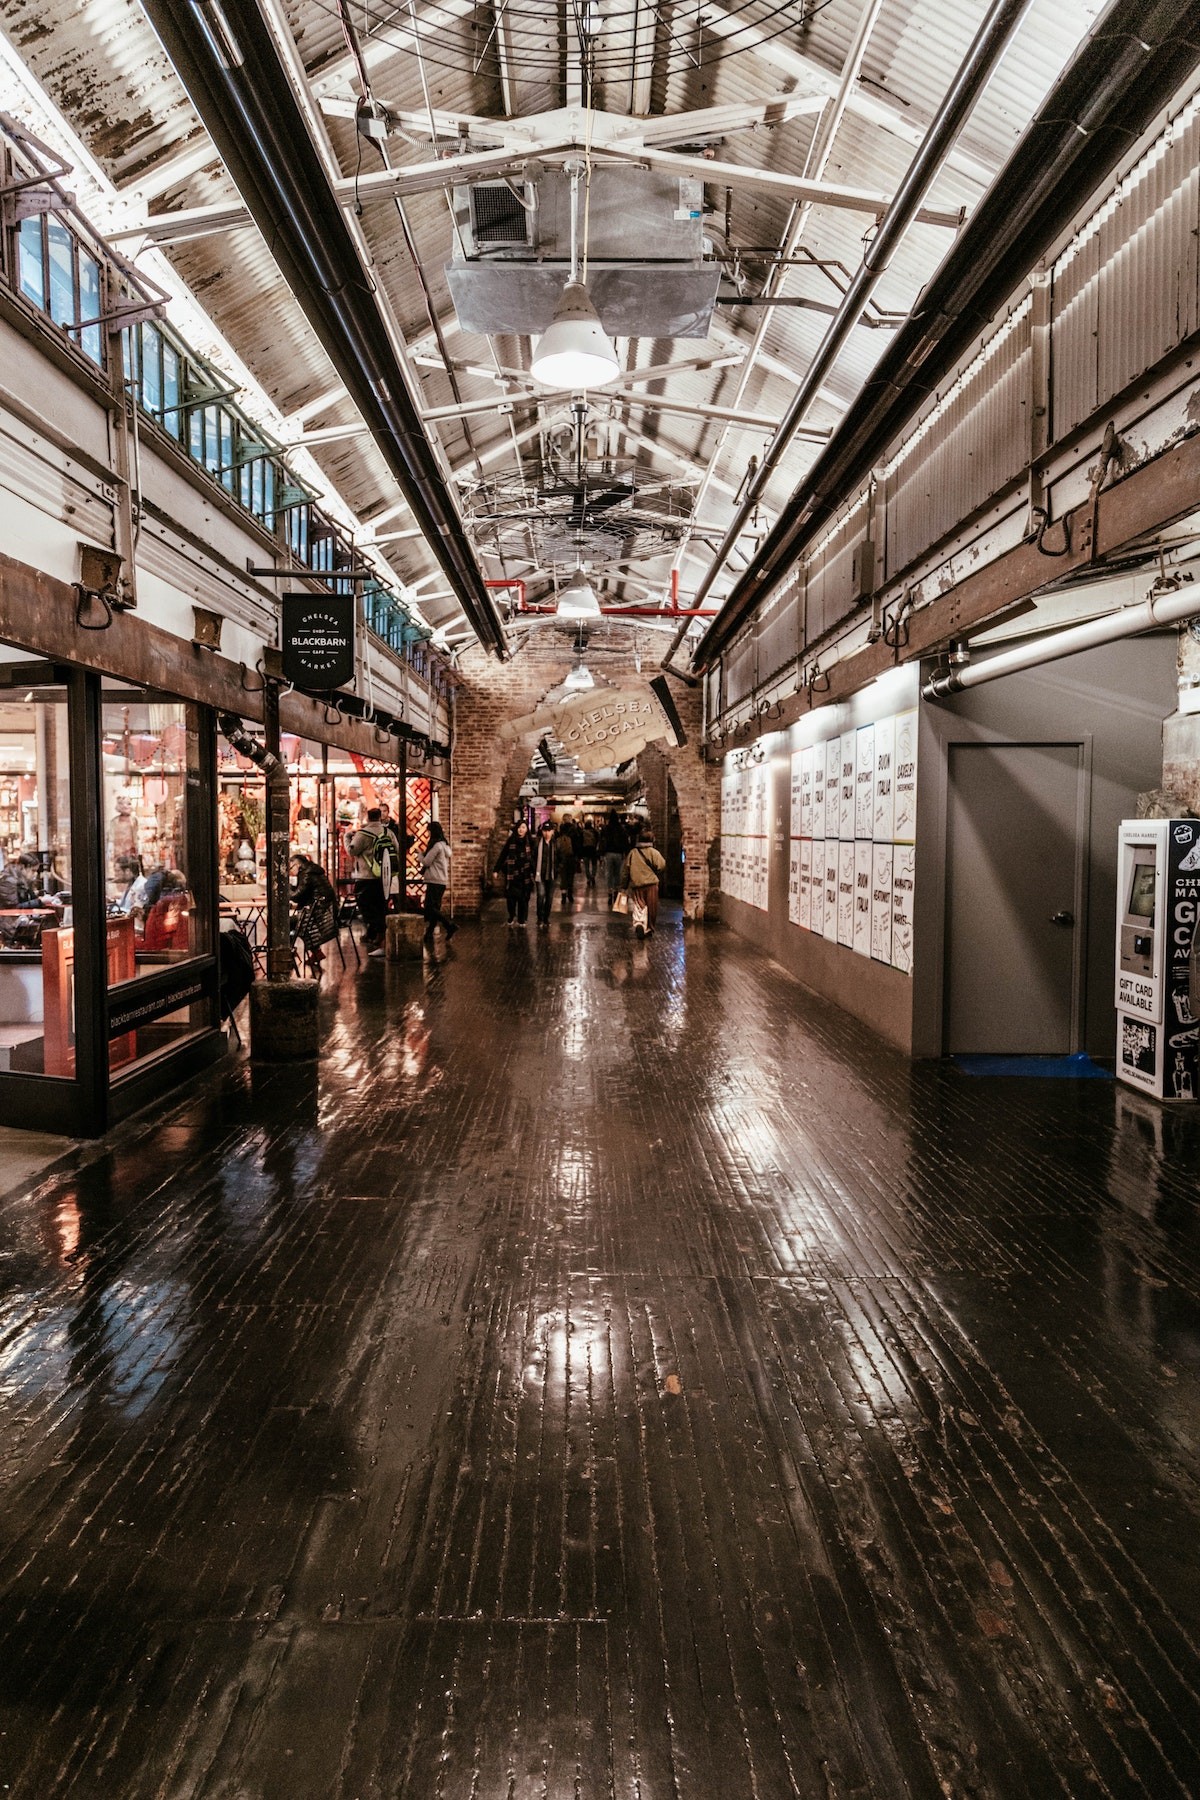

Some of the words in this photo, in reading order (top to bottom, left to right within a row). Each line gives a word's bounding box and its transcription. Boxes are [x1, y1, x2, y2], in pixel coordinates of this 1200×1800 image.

[302, 613, 339, 626] CHELSEA
[291, 637, 347, 646] BLACKBARN
[301, 658, 337, 670] MARKET
[568, 701, 654, 741] CHELSEA
[659, 708, 673, 730] SHOP
[583, 717, 646, 745] LOCAL
[878, 753, 891, 771] BUON
[877, 779, 891, 796] ITALIA
[857, 873, 868, 888] BUON
[1120, 978, 1133, 991] GIFT
[1135, 982, 1153, 998] CARD
[1119, 991, 1153, 1012] AVAILABLE
